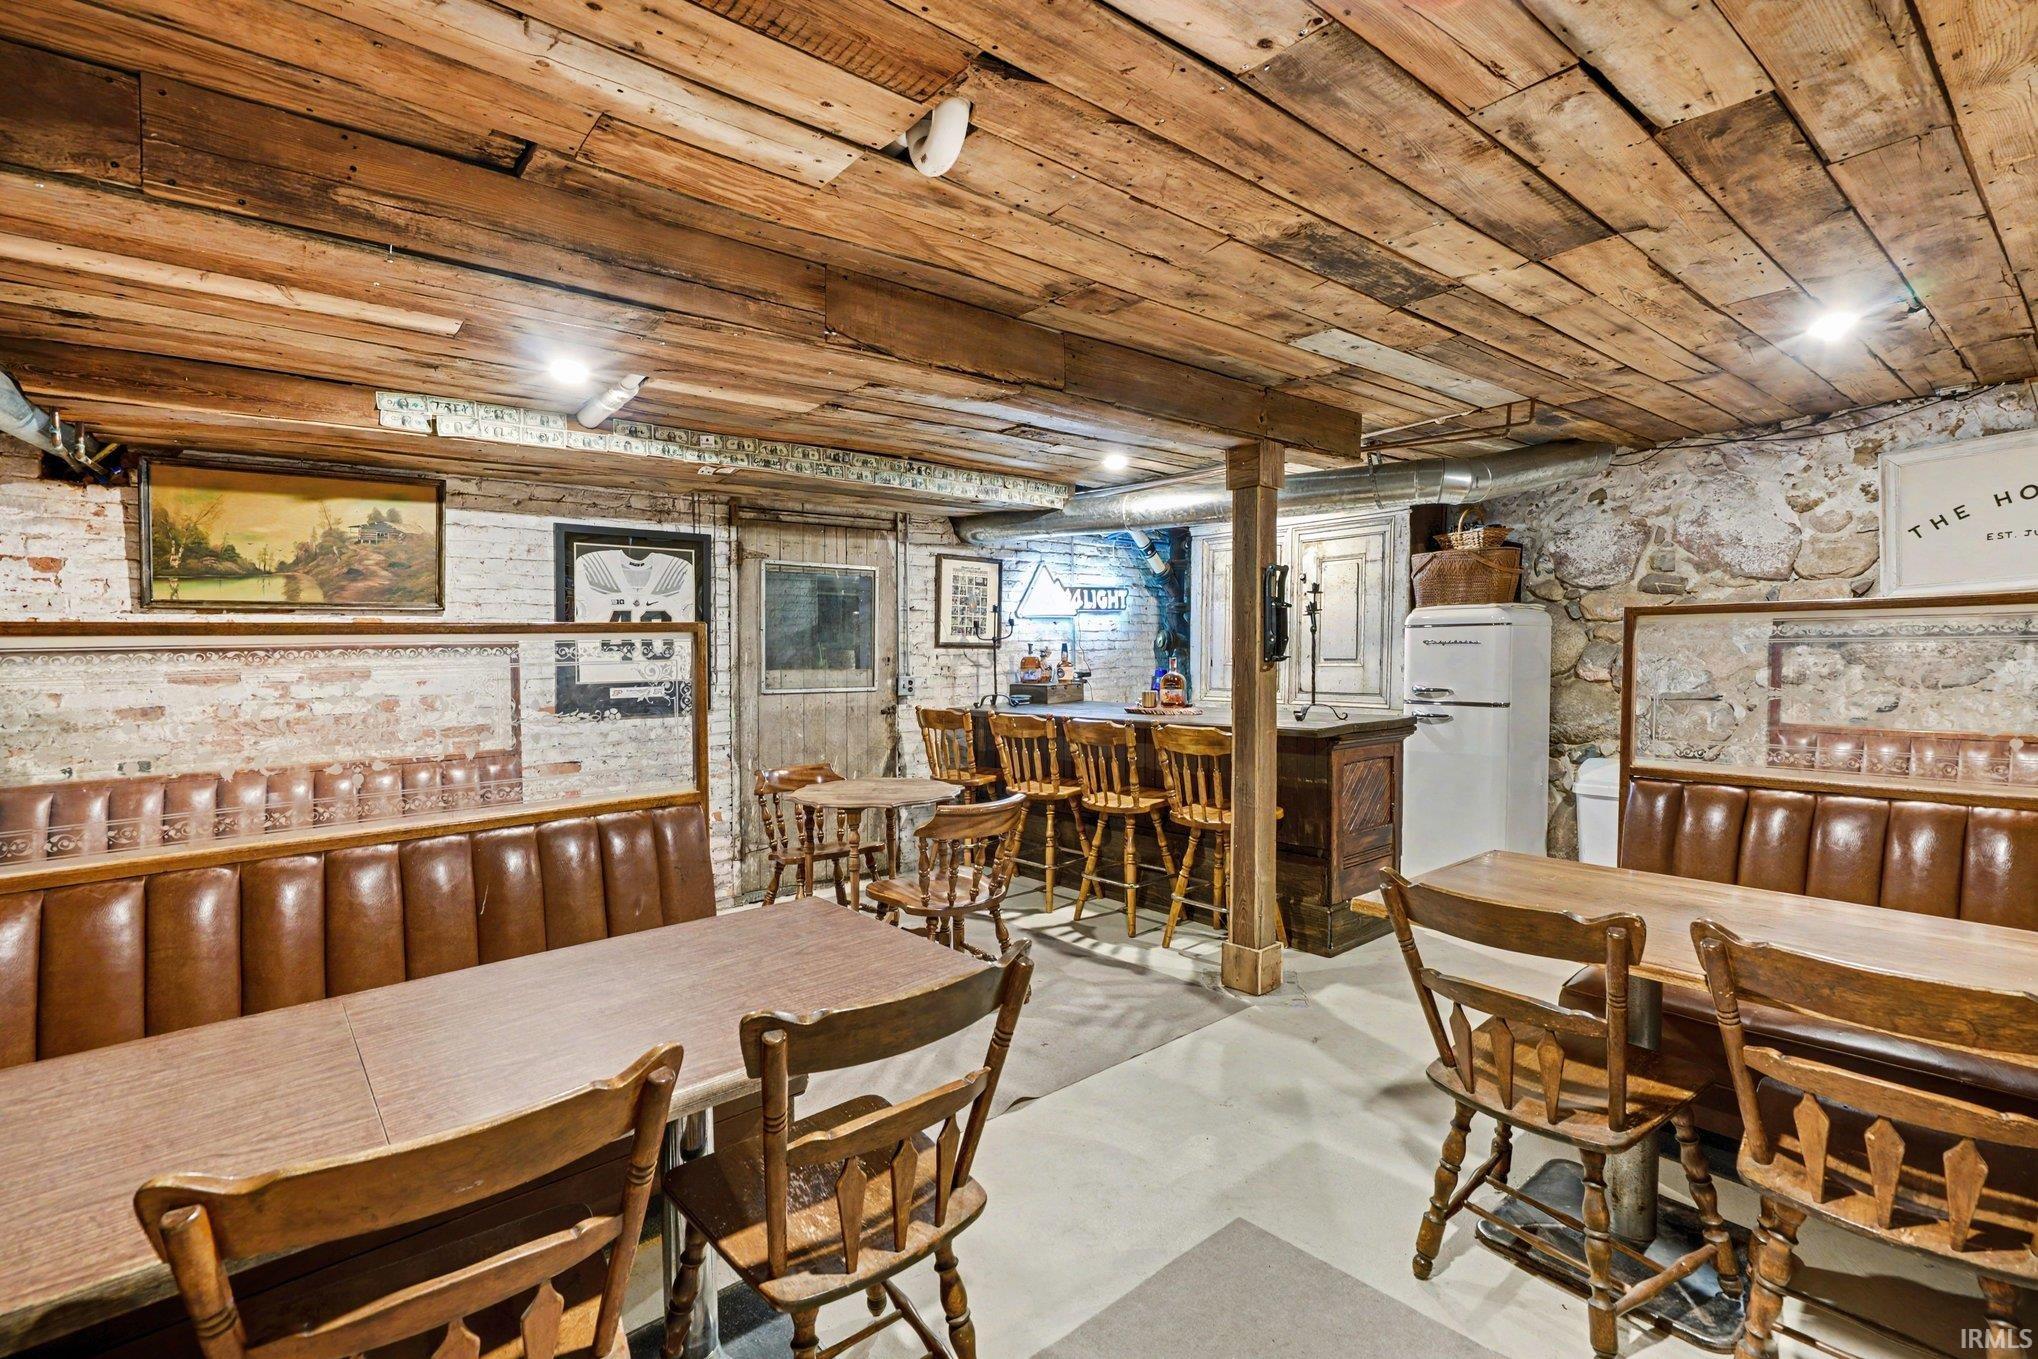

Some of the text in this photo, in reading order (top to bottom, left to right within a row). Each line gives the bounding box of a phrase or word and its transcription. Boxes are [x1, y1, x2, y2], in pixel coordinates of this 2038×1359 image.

[1908, 484, 2038, 539] THE HO
[1986, 531, 2017, 541] EST.
